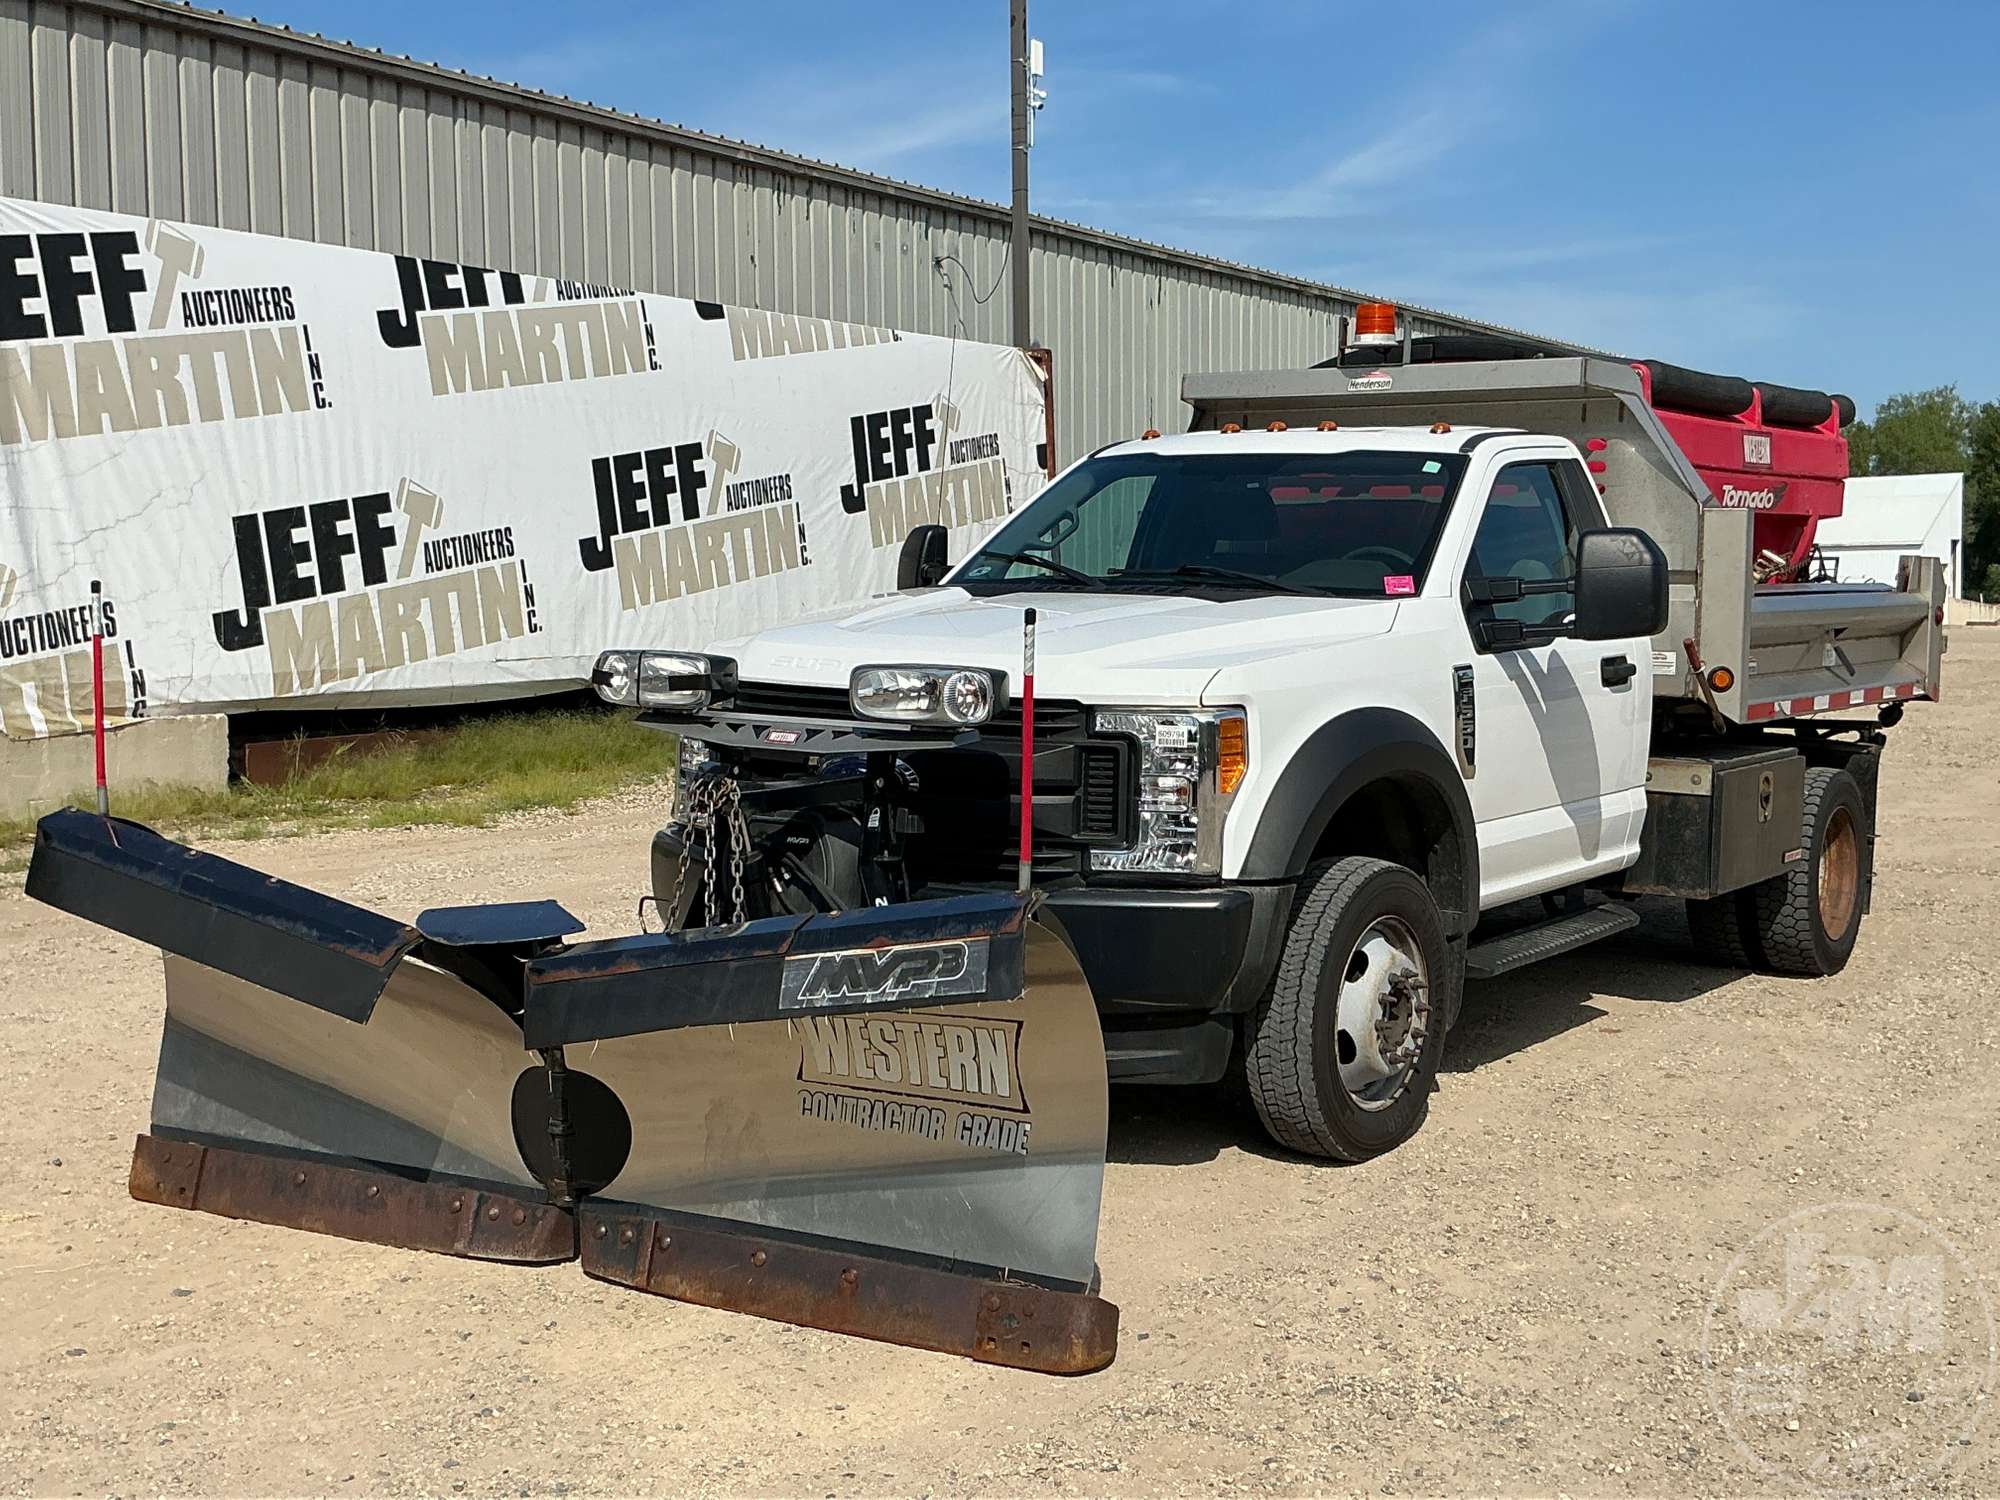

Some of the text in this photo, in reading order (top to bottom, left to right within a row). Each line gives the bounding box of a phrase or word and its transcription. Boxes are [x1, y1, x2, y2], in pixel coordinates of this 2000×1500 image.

[0, 232, 147, 341] EFF
[181, 286, 296, 328] AUCTIONEERS
[556, 279, 635, 301] AUCTIO
[303, 324, 333, 410] INC.
[421, 301, 647, 396] MARTIN
[641, 299, 663, 371] INC.
[0, 325, 310, 446] MARTIN
[1349, 380, 1391, 390] Henderson
[839, 403, 936, 515] JEFF
[950, 432, 1000, 466] AUCTIONEERS
[578, 441, 707, 572] JEFF
[726, 473, 793, 513] AUCTIONEERS
[866, 459, 1006, 548] MARTIN
[1722, 484, 1774, 509] Tornado
[424, 526, 515, 575] AUCTIONEERS
[613, 504, 800, 611] MARTIN
[796, 501, 813, 566] INC.
[213, 492, 397, 652] JEFF
[521, 559, 544, 634] INC.
[0, 600, 118, 659] UCTIONEES
[265, 562, 524, 697] MARTIN
[800, 1016, 1010, 1098] WESTERN
[798, 1089, 1032, 1156] CONTRACTOR GRADE
